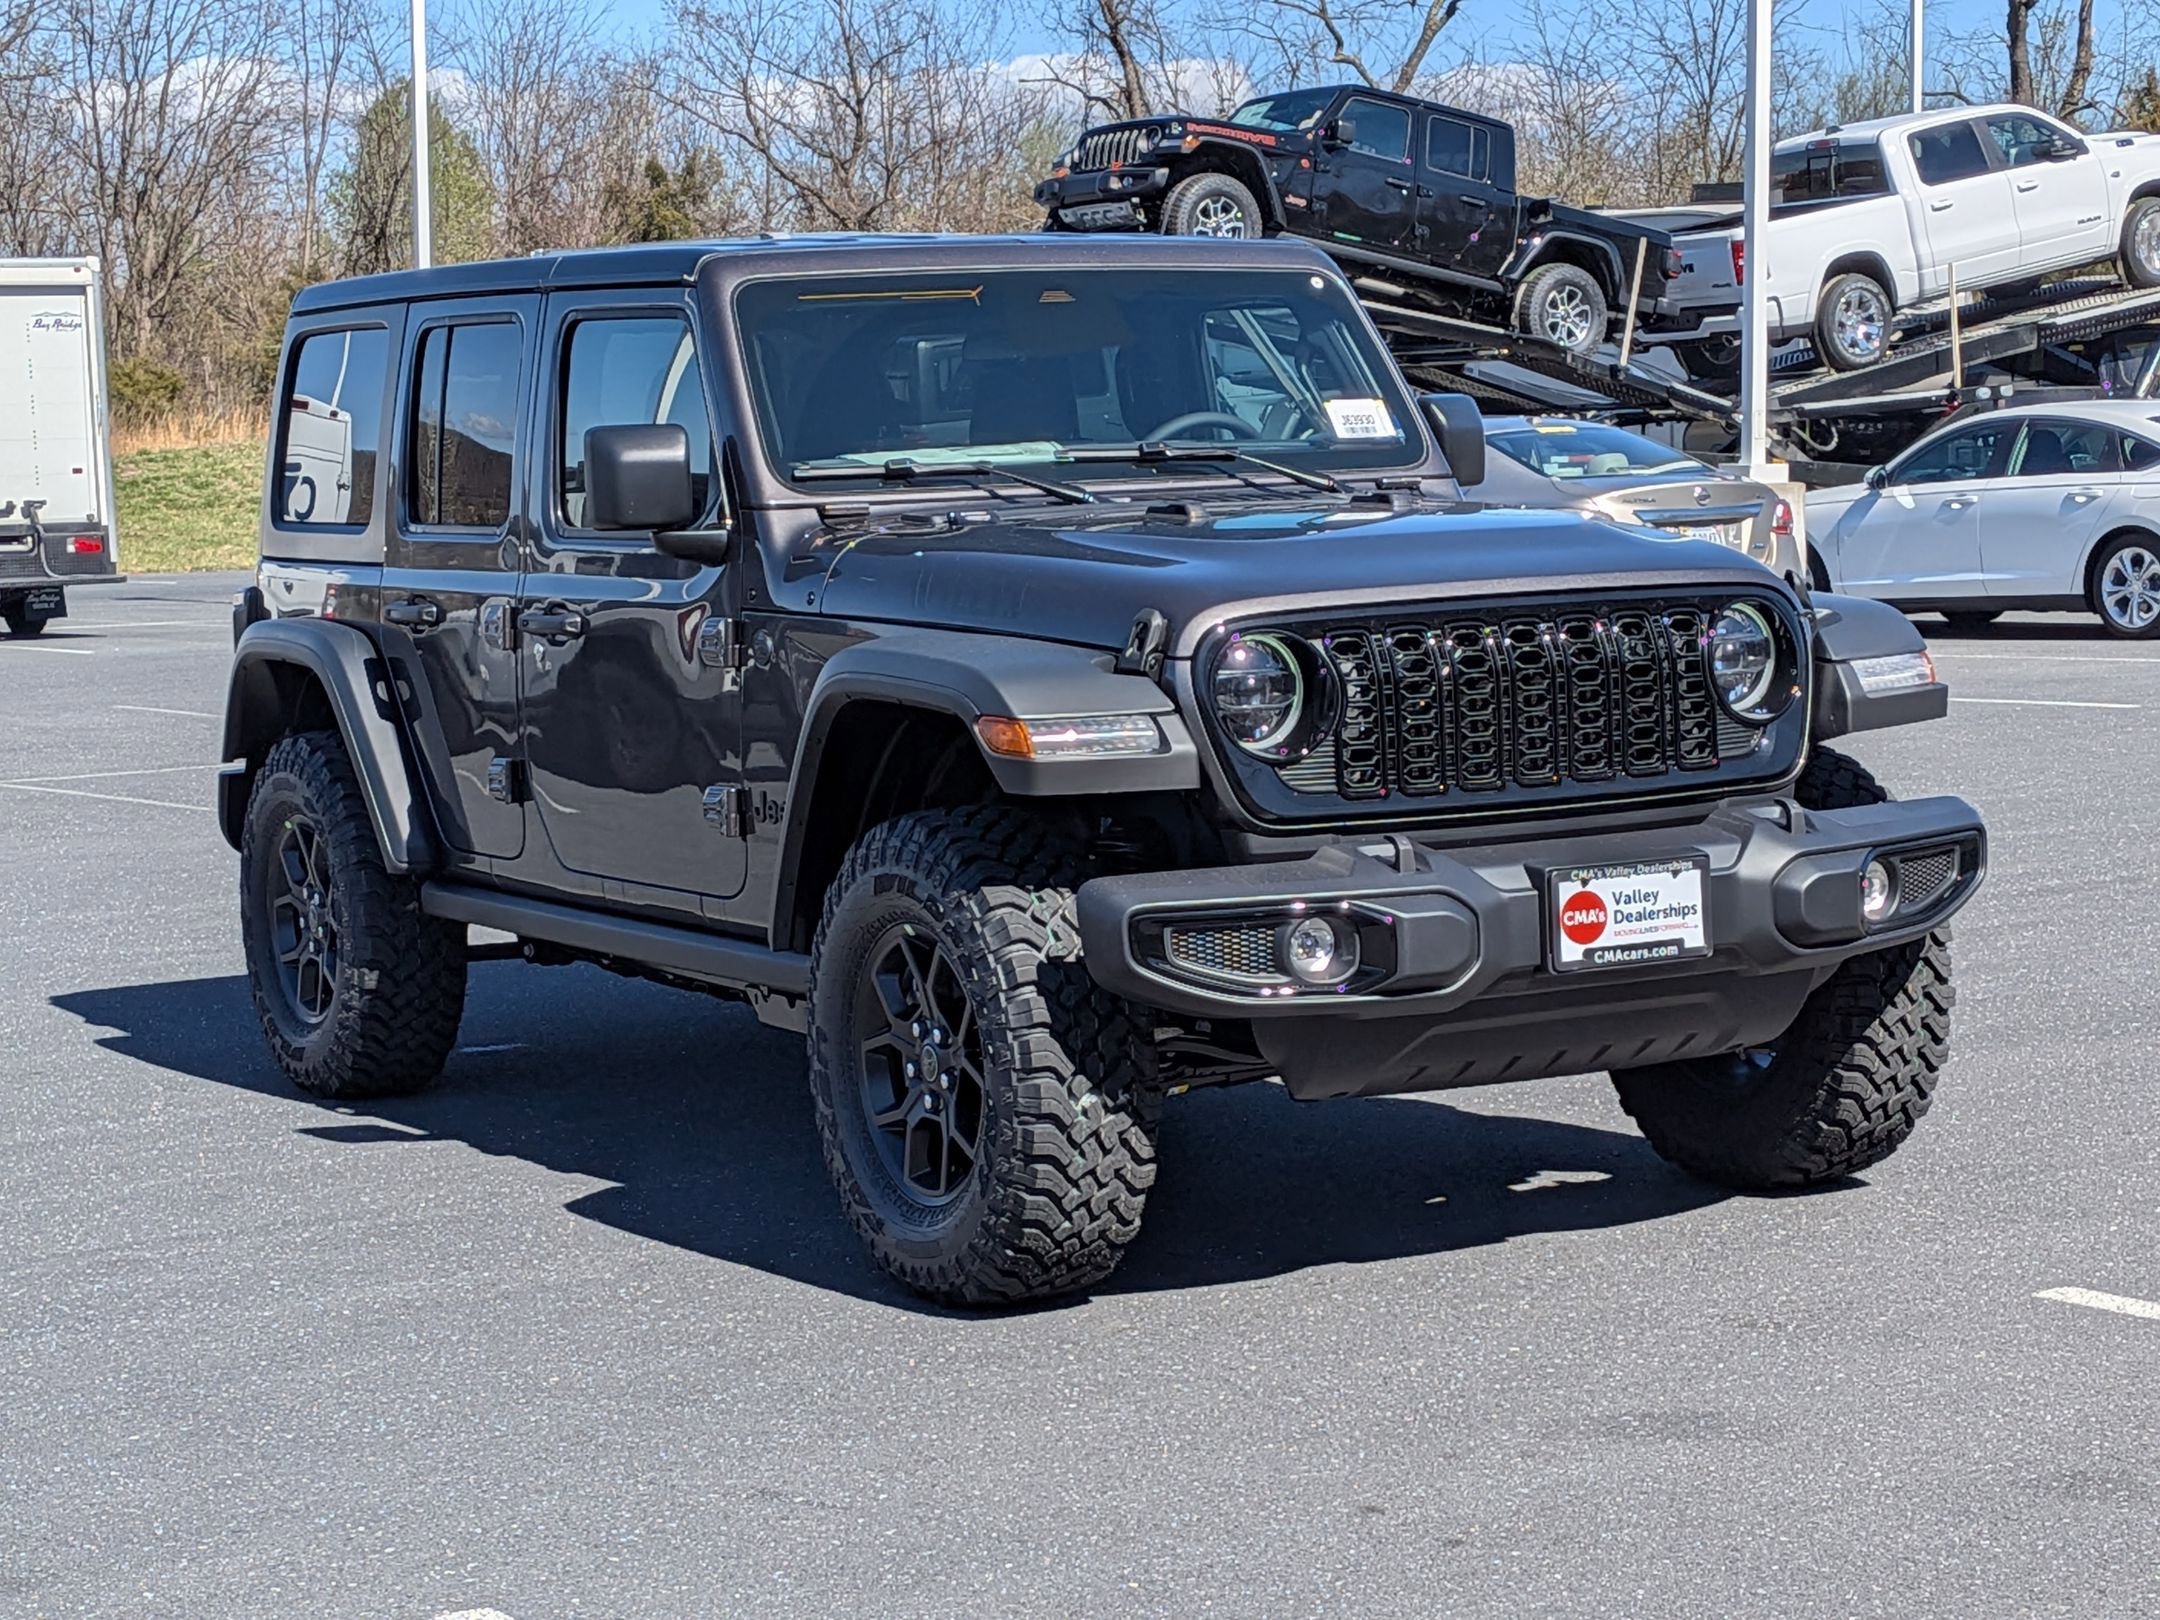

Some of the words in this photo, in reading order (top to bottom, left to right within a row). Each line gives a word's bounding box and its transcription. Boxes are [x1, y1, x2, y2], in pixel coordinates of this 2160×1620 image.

[32, 318, 50, 332] Bay
[1570, 868, 1602, 881] CMA's
[1604, 865, 1635, 879] Valley
[1636, 860, 1694, 875] Dealerships
[1611, 888, 1660, 906] Valley
[1563, 907, 1607, 926] CMA's
[1613, 902, 1698, 925] Dealerships
[1594, 945, 1679, 964] CMAcars.com
